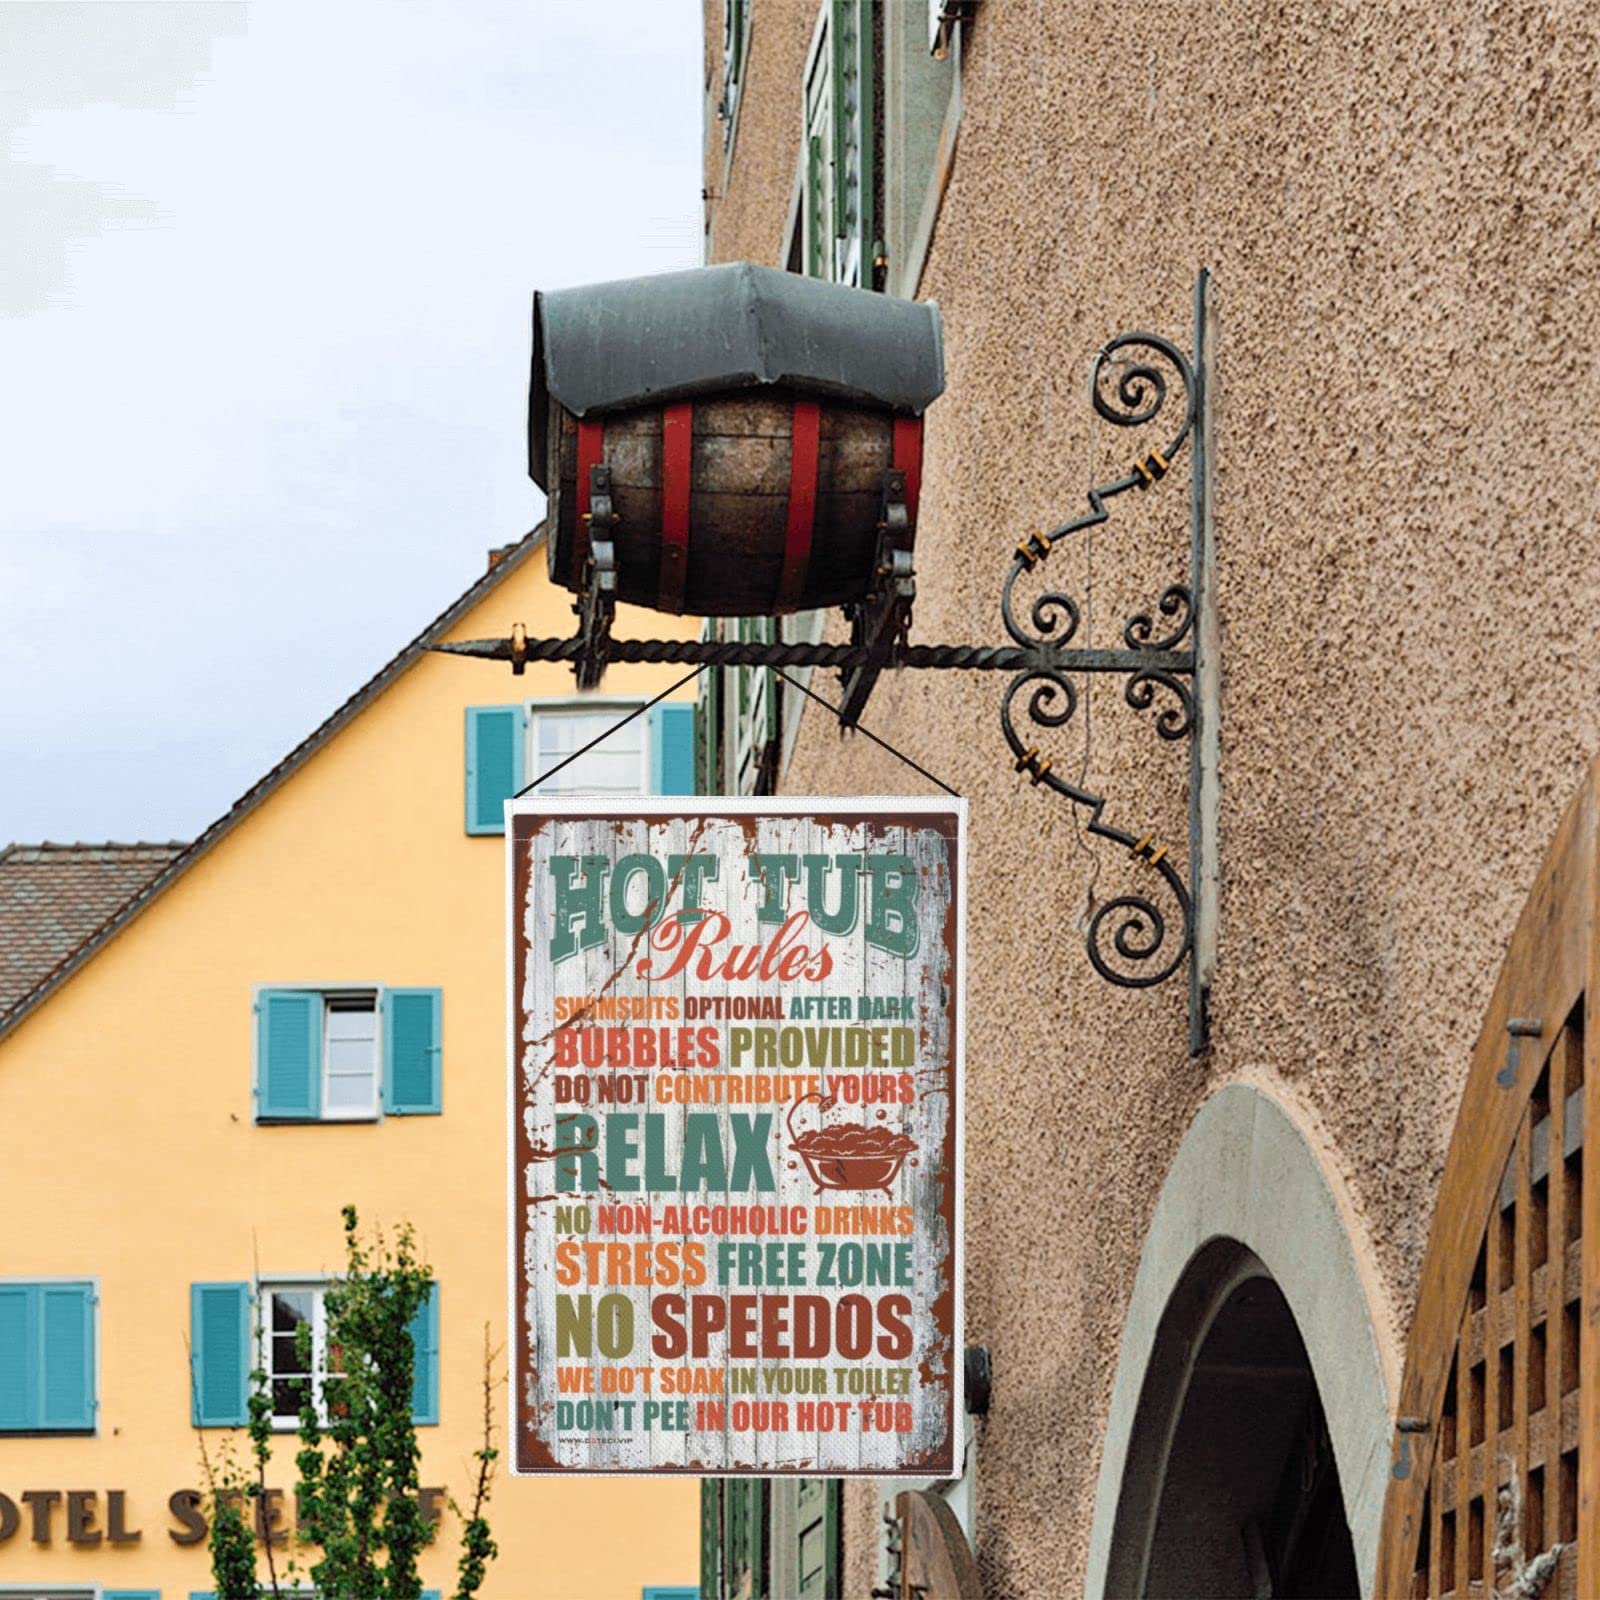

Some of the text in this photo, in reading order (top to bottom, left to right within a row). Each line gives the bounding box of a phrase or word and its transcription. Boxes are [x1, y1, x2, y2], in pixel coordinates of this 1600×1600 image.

[548, 852, 921, 966] HOT TUB
[635, 907, 834, 983] Rules
[554, 996, 915, 1020] SWIMSUITS OPTIONAL AFTER DARK
[554, 1026, 916, 1069] BUBBLES PROVIDED
[554, 1074, 916, 1105] DO NOT CONTRIBUTE YOURS
[554, 1113, 777, 1192] RELAX
[555, 1205, 915, 1236] NO NON-ALCOHOLIC DRINKS
[555, 1242, 914, 1287] STRESS FREE ZONE
[555, 1293, 915, 1361] NO SPEEDOS
[556, 1366, 914, 1395] WE DO'T SOAK IN YOUR TOILET
[556, 1400, 914, 1433] DON'T PEE IN OUR HOT TUB
